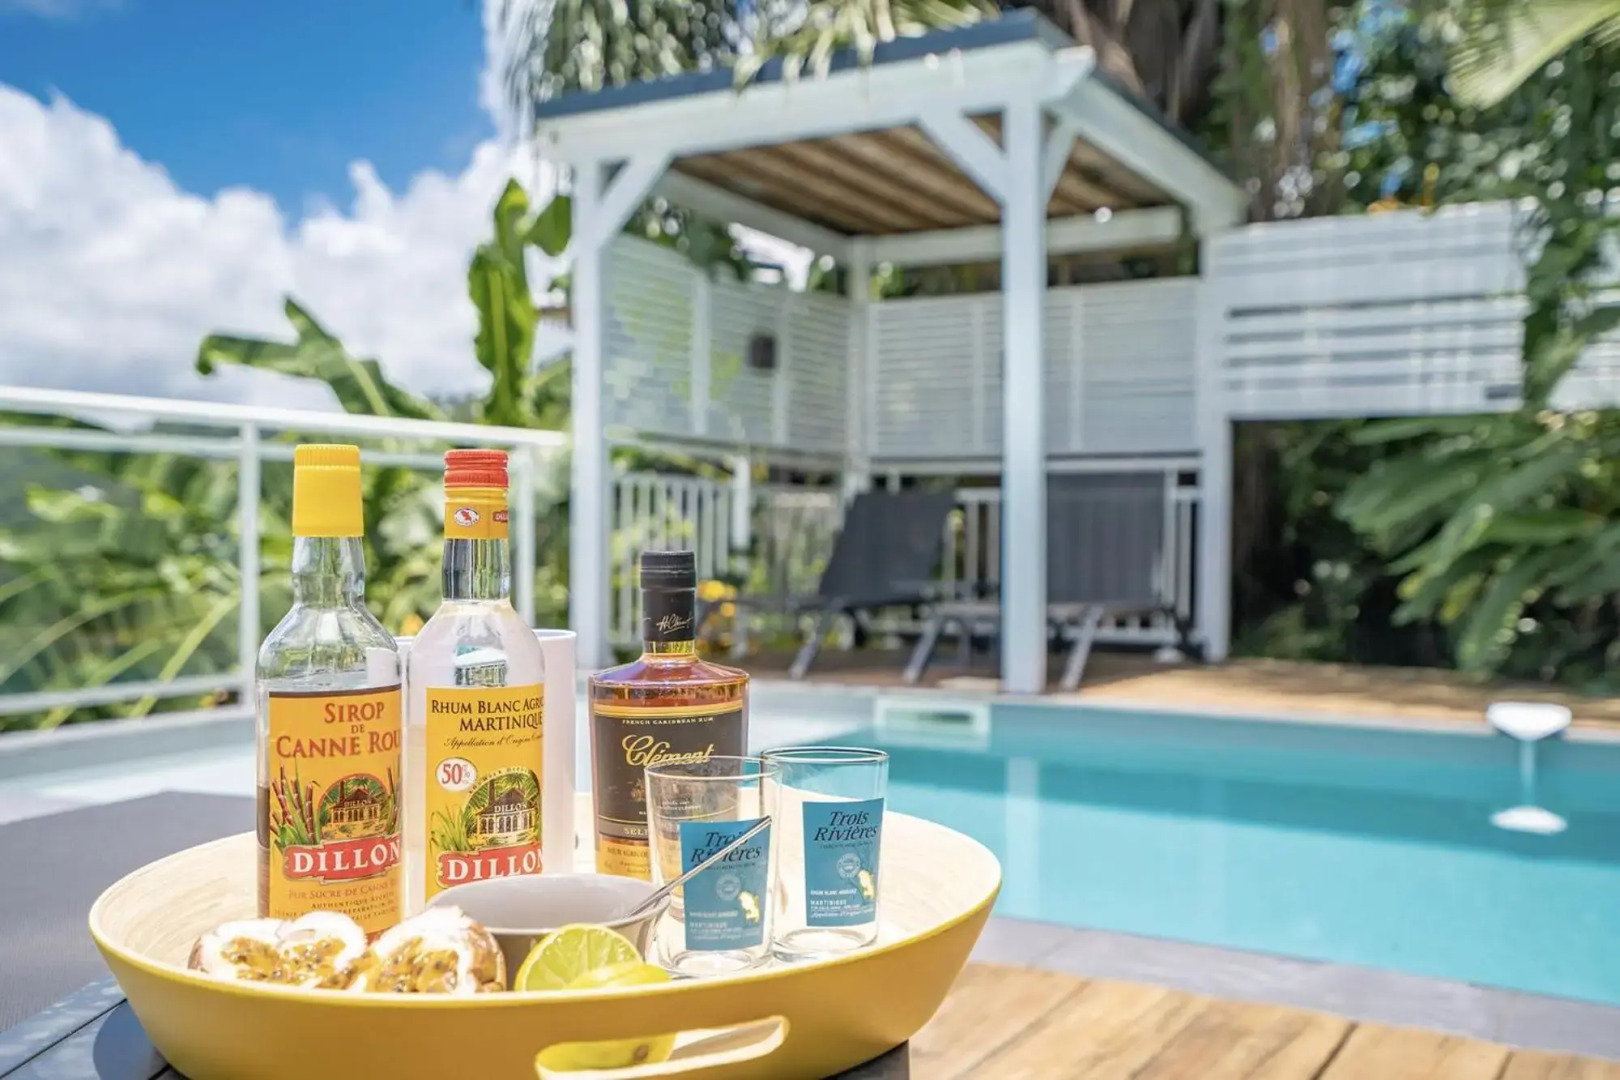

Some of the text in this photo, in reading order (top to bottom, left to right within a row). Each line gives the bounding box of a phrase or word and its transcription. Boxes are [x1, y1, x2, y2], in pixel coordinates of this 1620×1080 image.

[324, 701, 385, 724] SIROP
[431, 699, 473, 714] RHUM
[478, 700, 520, 714] BLANC
[350, 724, 366, 734] DE
[459, 711, 543, 732] MARTINIQUE
[276, 735, 362, 758] CANNE
[444, 735, 495, 750] Appellation
[622, 734, 715, 767] Clément
[495, 803, 527, 813] DILLON
[830, 811, 869, 826] Trois
[813, 825, 877, 841] Rivières
[292, 838, 400, 873] DILLON
[309, 889, 342, 899] SUCRE
[345, 887, 358, 897] DE
